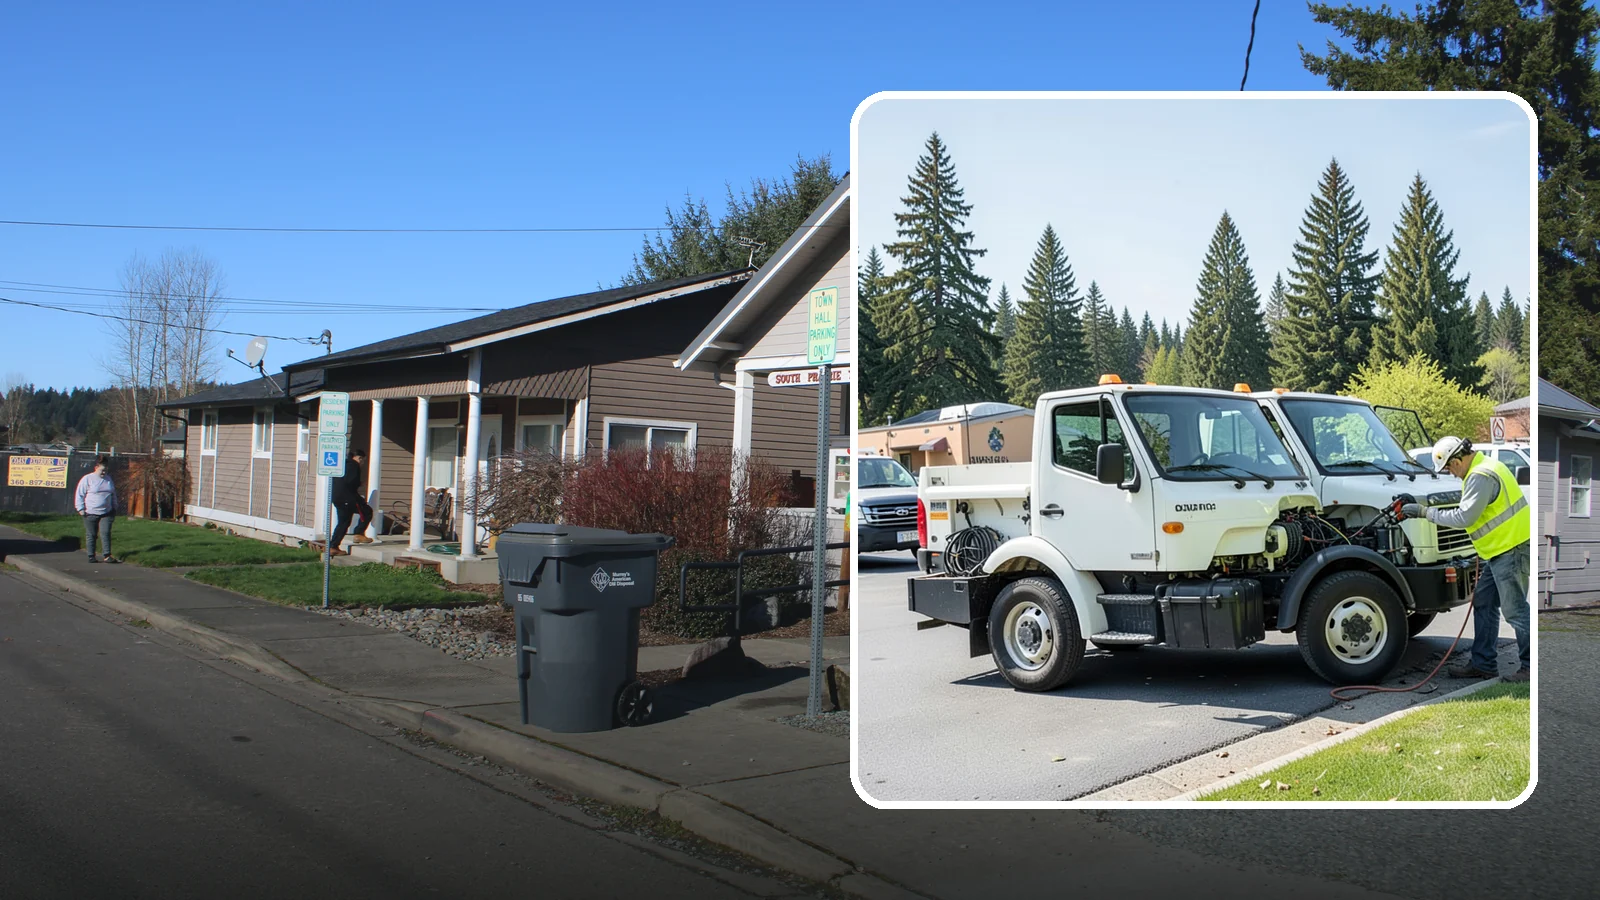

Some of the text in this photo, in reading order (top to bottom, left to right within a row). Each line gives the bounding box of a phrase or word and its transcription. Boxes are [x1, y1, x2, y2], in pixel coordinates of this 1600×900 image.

[815, 294, 833, 308] TOWN
[814, 311, 831, 324] HALL
[810, 327, 836, 341] PARKING
[813, 344, 831, 357] ONLY
[775, 374, 801, 384] SOUTH
[808, 371, 841, 382] PRIE
